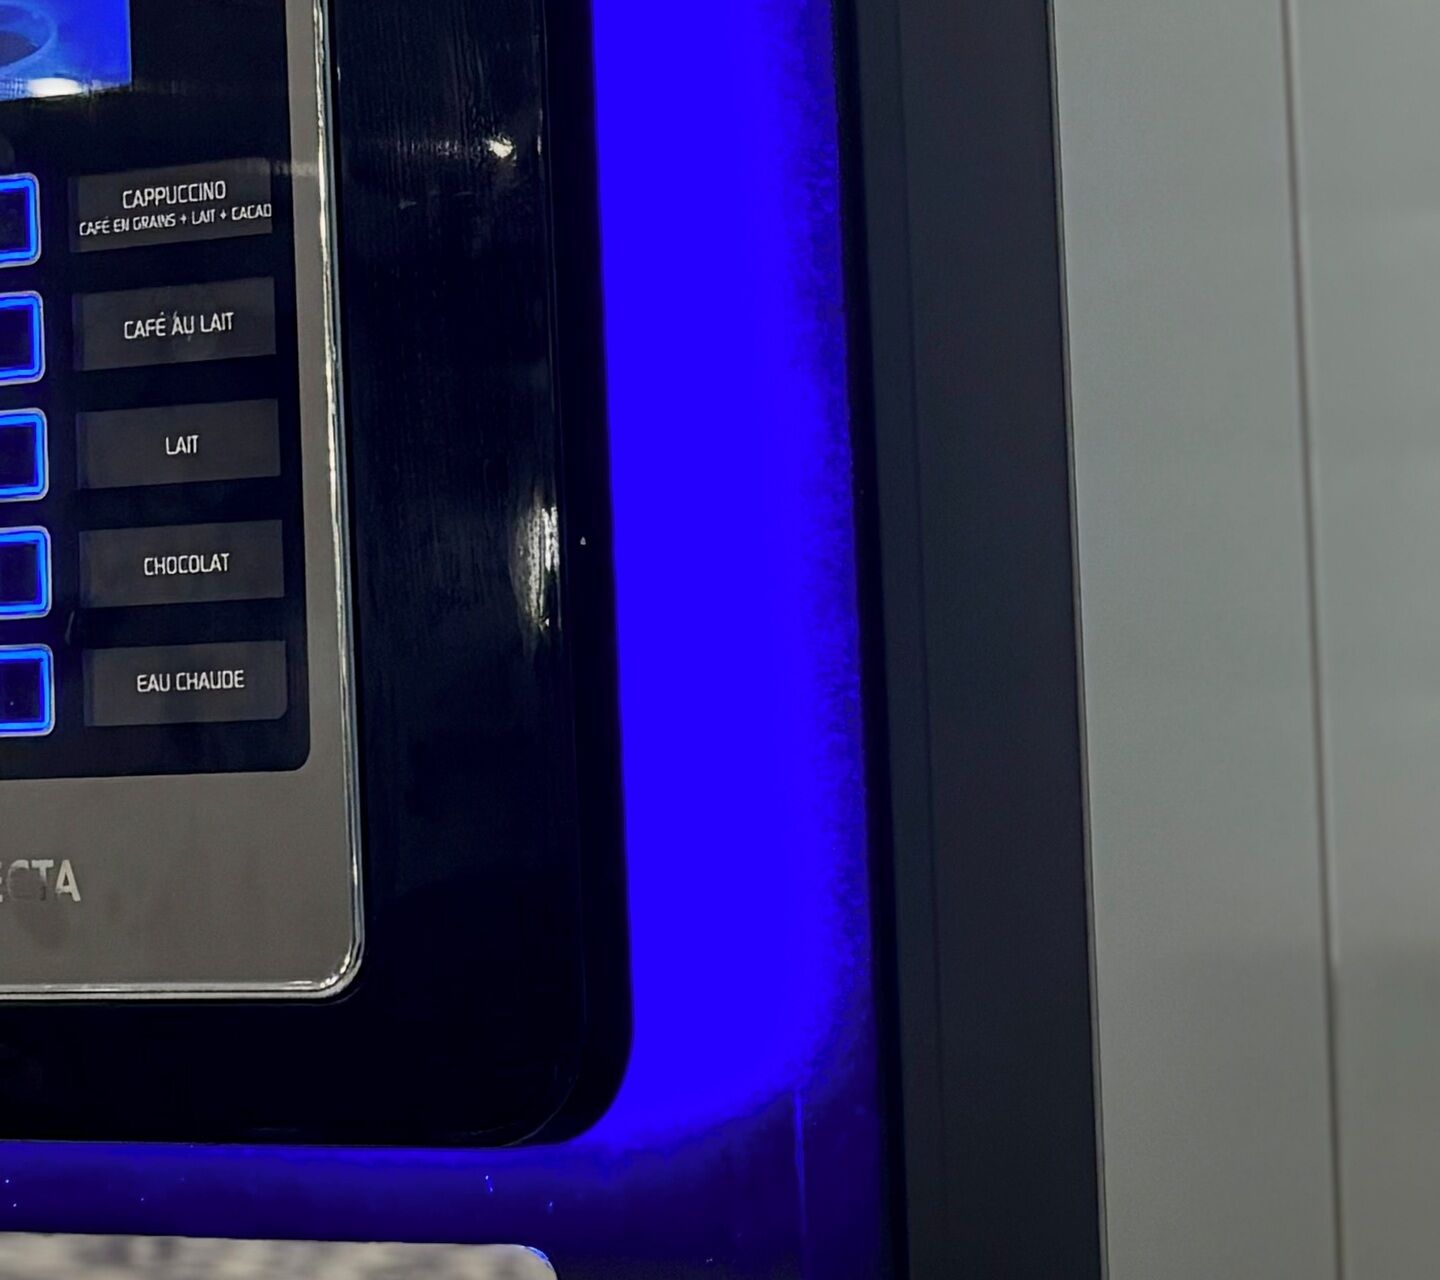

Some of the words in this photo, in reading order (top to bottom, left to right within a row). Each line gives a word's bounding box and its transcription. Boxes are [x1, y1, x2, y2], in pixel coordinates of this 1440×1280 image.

[122, 180, 226, 209] CAPPUCCINO
[113, 218, 130, 234] EN
[133, 213, 176, 231] GRAINS
[191, 208, 216, 225] LAIT
[231, 203, 272, 222] CACAO
[124, 311, 167, 340] CAFÉ
[171, 315, 195, 335] AU
[200, 312, 234, 332] LAIT
[165, 435, 199, 456] LAIT
[144, 553, 230, 576] CHOCOLAT
[137, 674, 170, 693] EAU
[175, 670, 245, 691] CHAUDE
[0, 859, 82, 903] CTA
